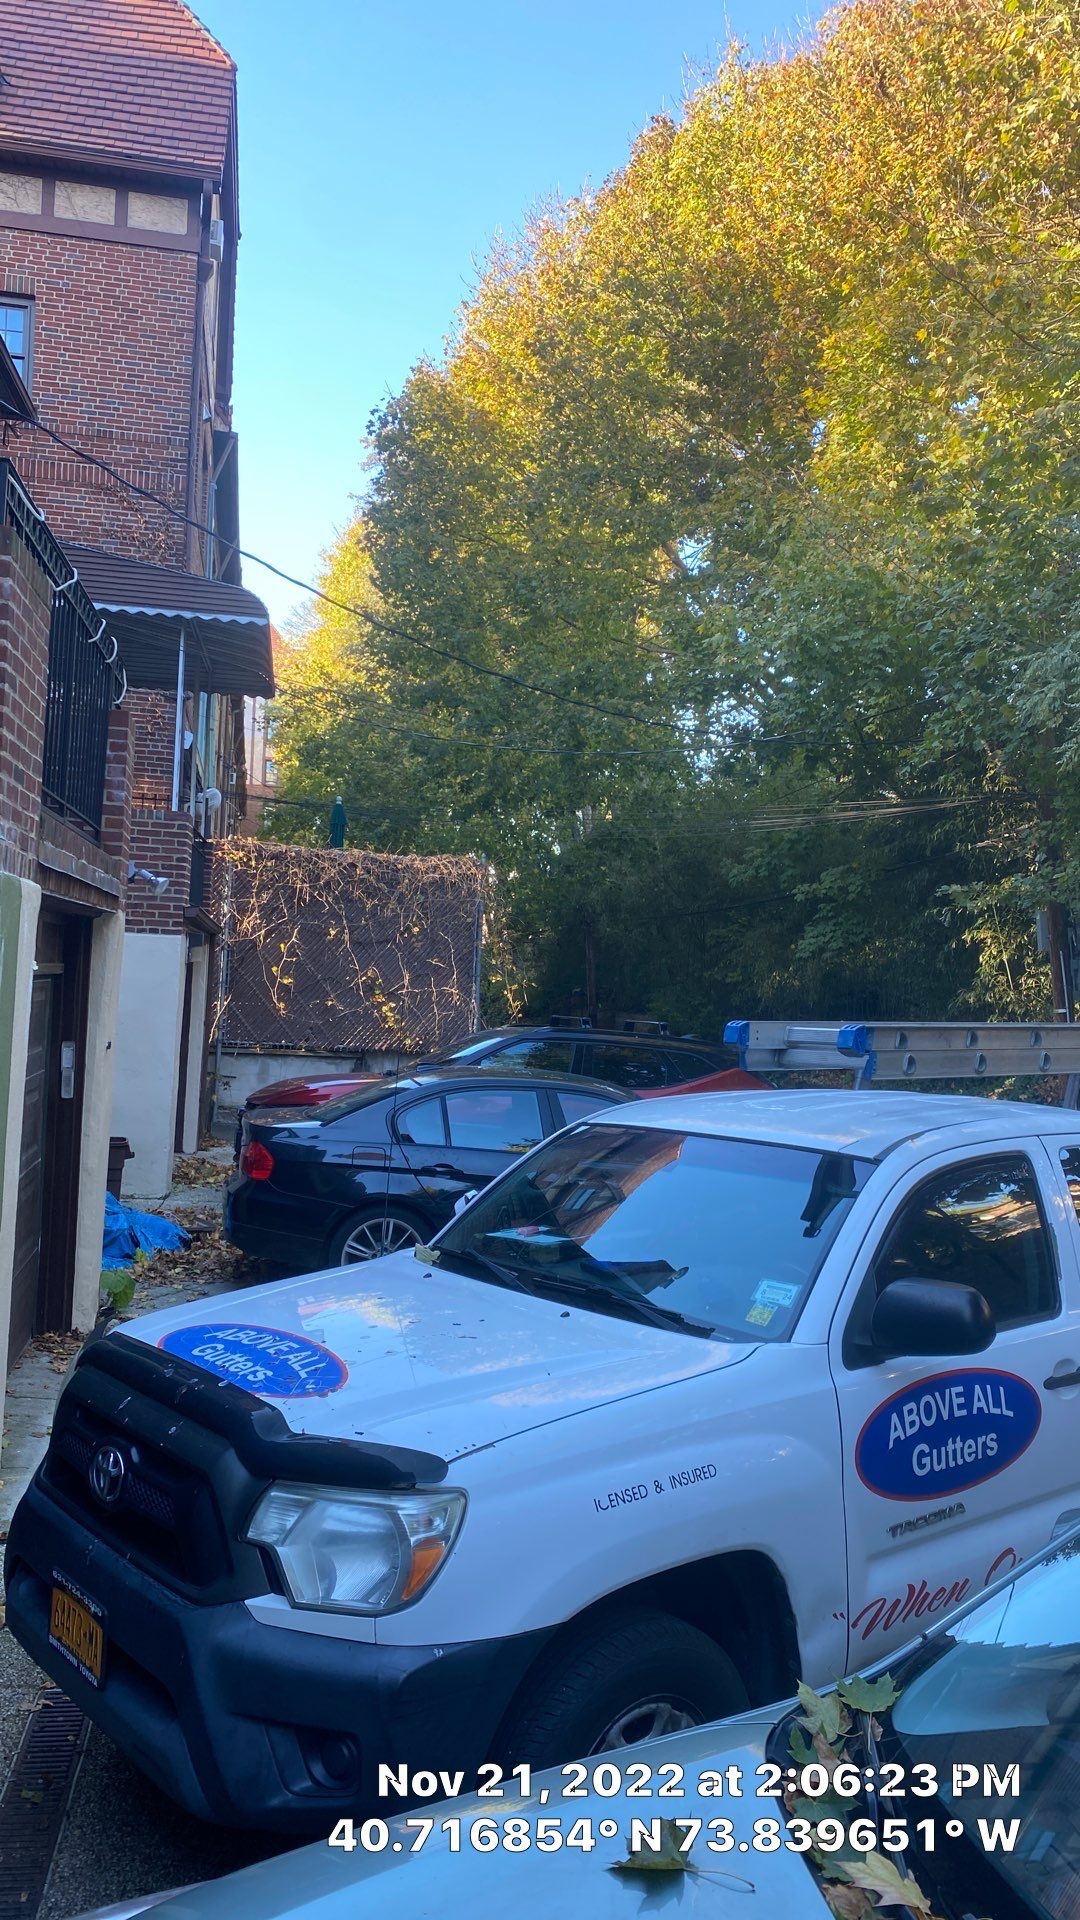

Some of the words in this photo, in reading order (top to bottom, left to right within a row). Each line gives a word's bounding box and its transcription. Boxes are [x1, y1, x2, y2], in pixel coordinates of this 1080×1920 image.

[191, 1343, 274, 1382] Gutters
[209, 1327, 301, 1356] ABOVE
[284, 1350, 330, 1379] ALL
[888, 1385, 967, 1450] ABOVE
[972, 1384, 1014, 1418] ALL
[911, 1432, 999, 1477] Gutters
[653, 1479, 665, 1494] &
[668, 1463, 717, 1490] INSURED
[887, 1501, 967, 1539] TACOMA
